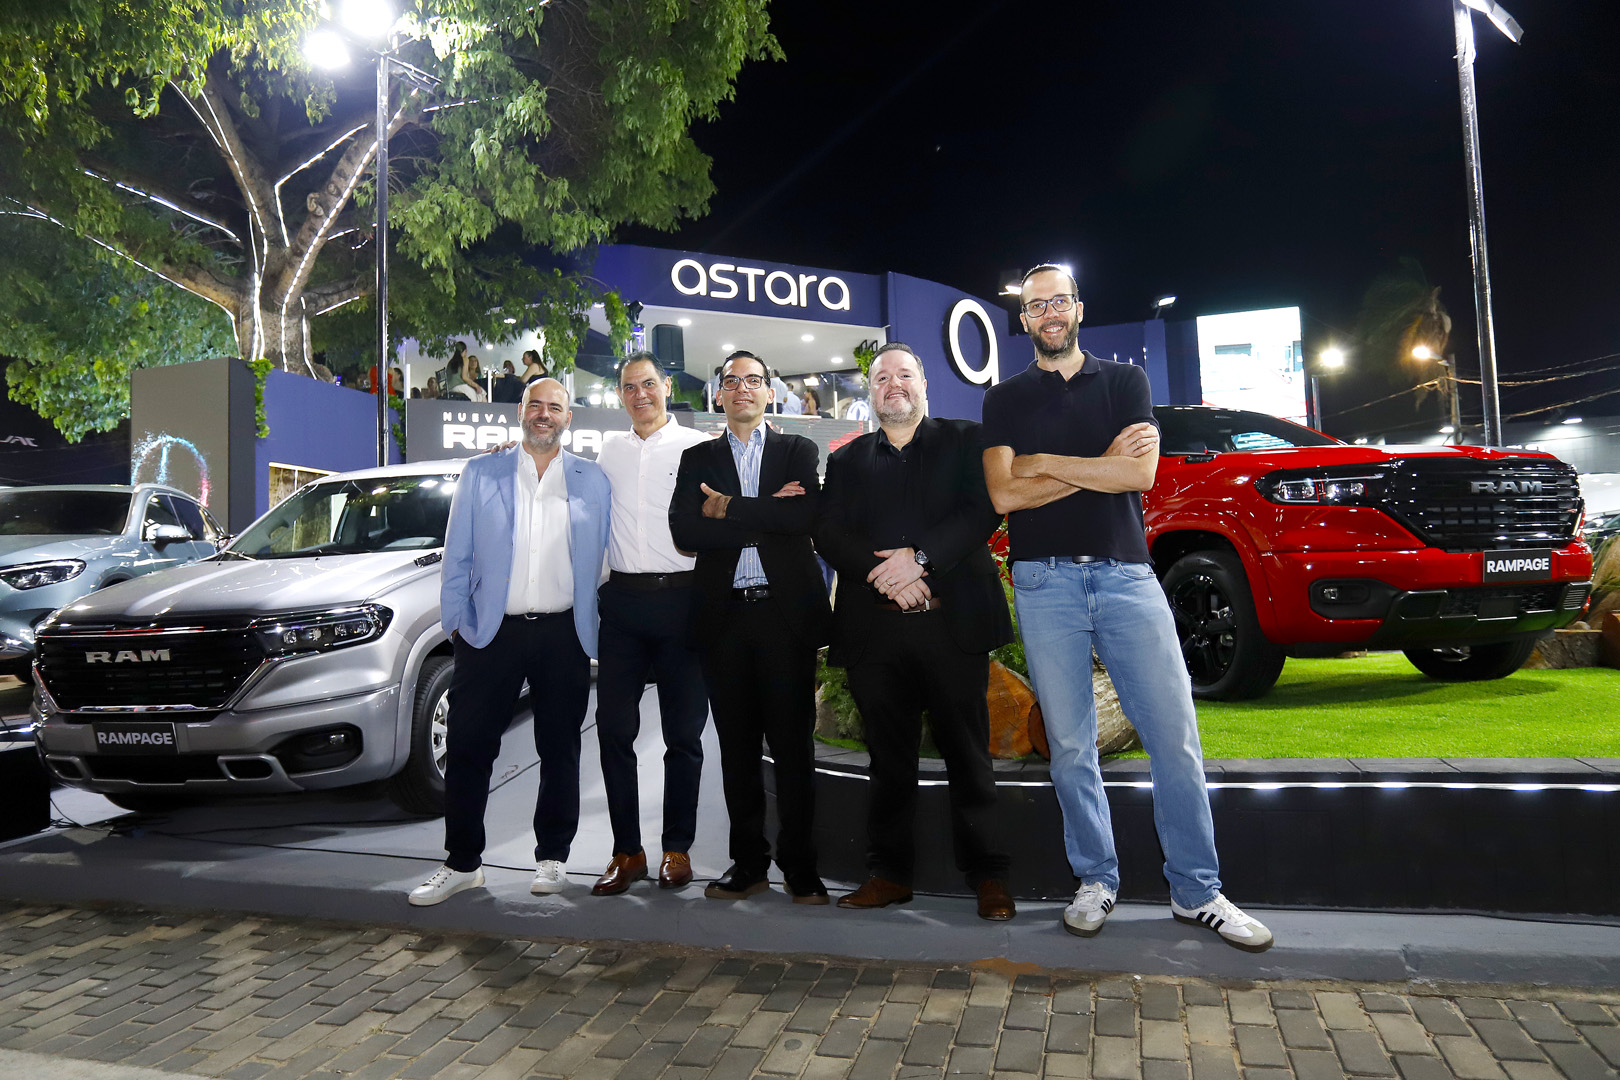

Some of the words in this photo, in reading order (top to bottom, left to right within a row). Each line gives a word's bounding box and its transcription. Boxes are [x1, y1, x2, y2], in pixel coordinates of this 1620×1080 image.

[671, 258, 851, 312] astara
[442, 411, 507, 424] NUEVA
[1470, 480, 1543, 494] RAM
[1486, 557, 1550, 573] RAMPAGE
[85, 648, 171, 664] RAM
[96, 731, 173, 745] RAMPAGE
